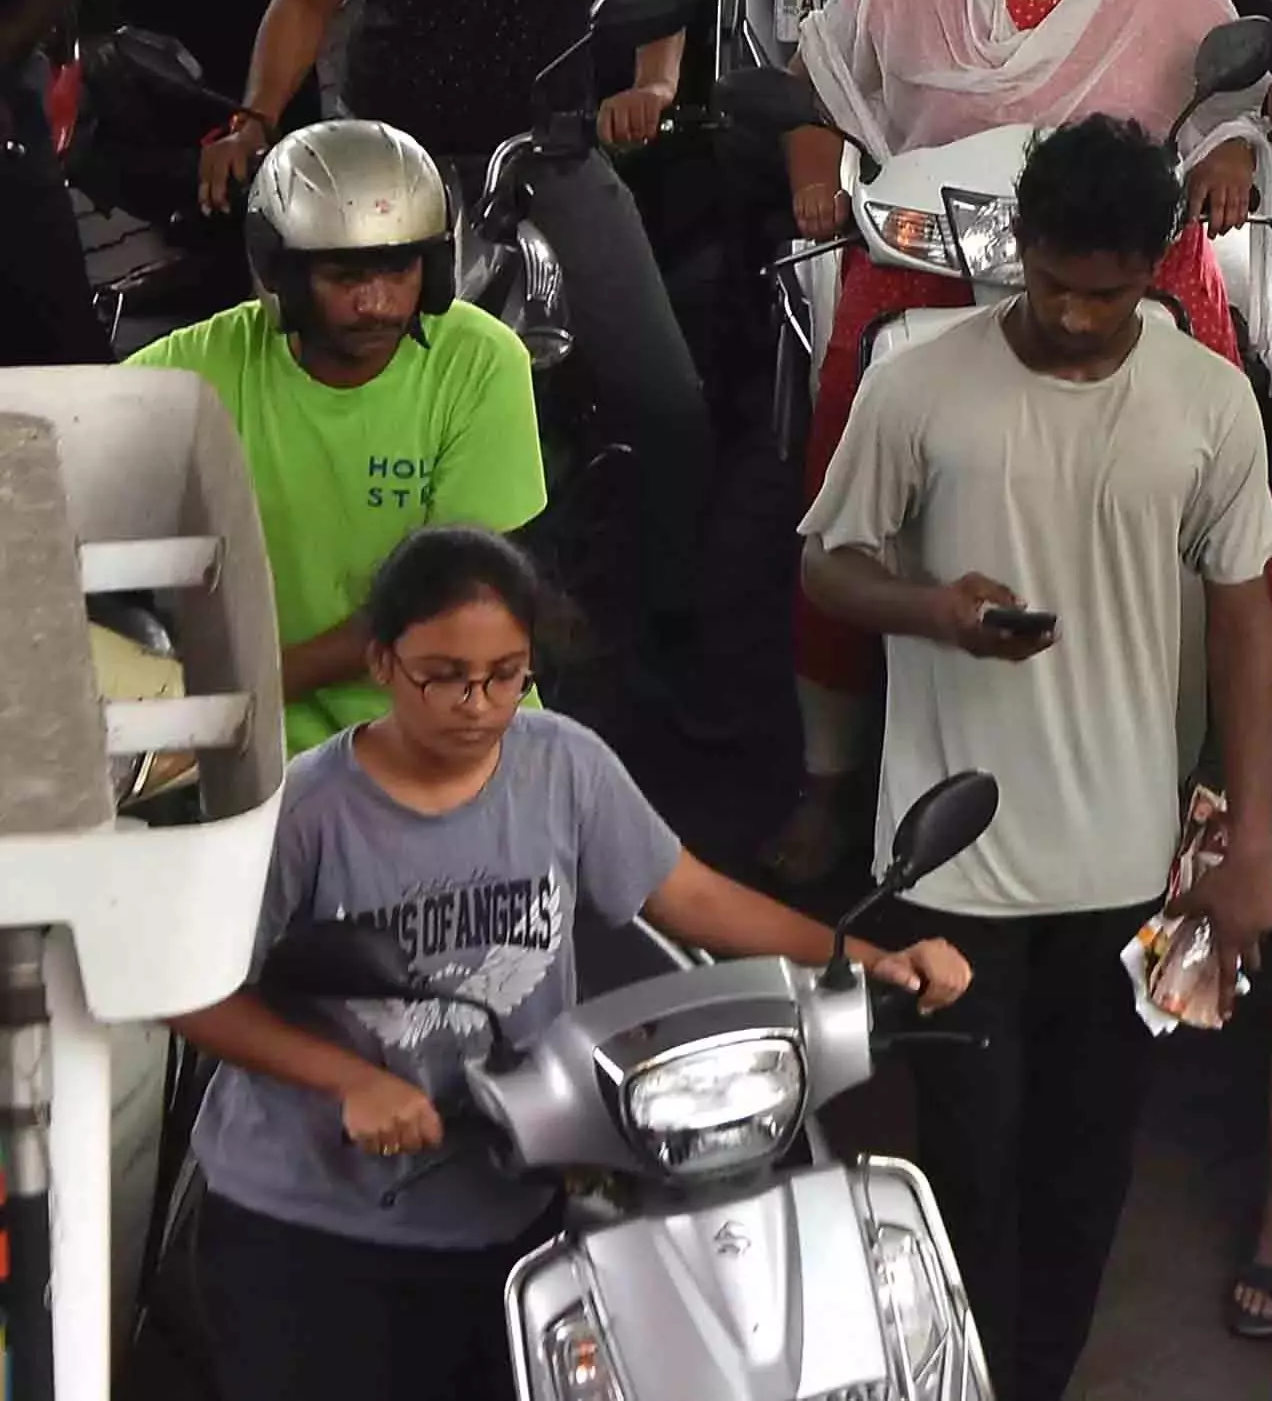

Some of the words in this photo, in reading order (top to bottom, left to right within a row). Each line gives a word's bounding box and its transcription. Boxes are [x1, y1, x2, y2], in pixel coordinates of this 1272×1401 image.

[368, 455, 433, 479] HOL
[367, 485, 430, 508] ST
[422, 894, 455, 956] OF
[455, 875, 551, 951] ANGELS
